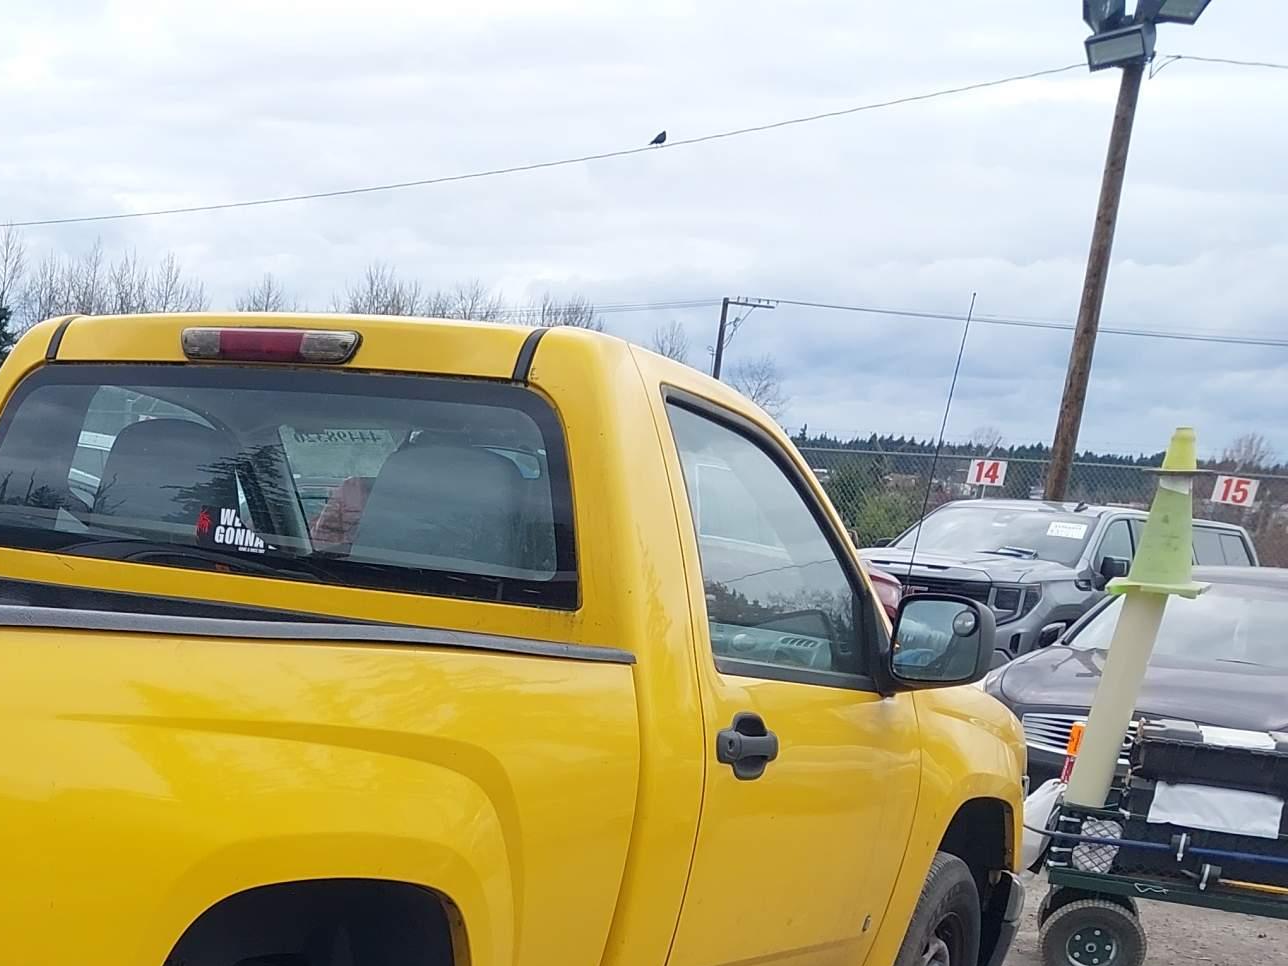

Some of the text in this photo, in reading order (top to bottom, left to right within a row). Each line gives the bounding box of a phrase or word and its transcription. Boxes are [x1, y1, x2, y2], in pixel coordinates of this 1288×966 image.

[975, 461, 1001, 484] 14
[1220, 478, 1251, 504] 15
[214, 525, 265, 549] GONNA
